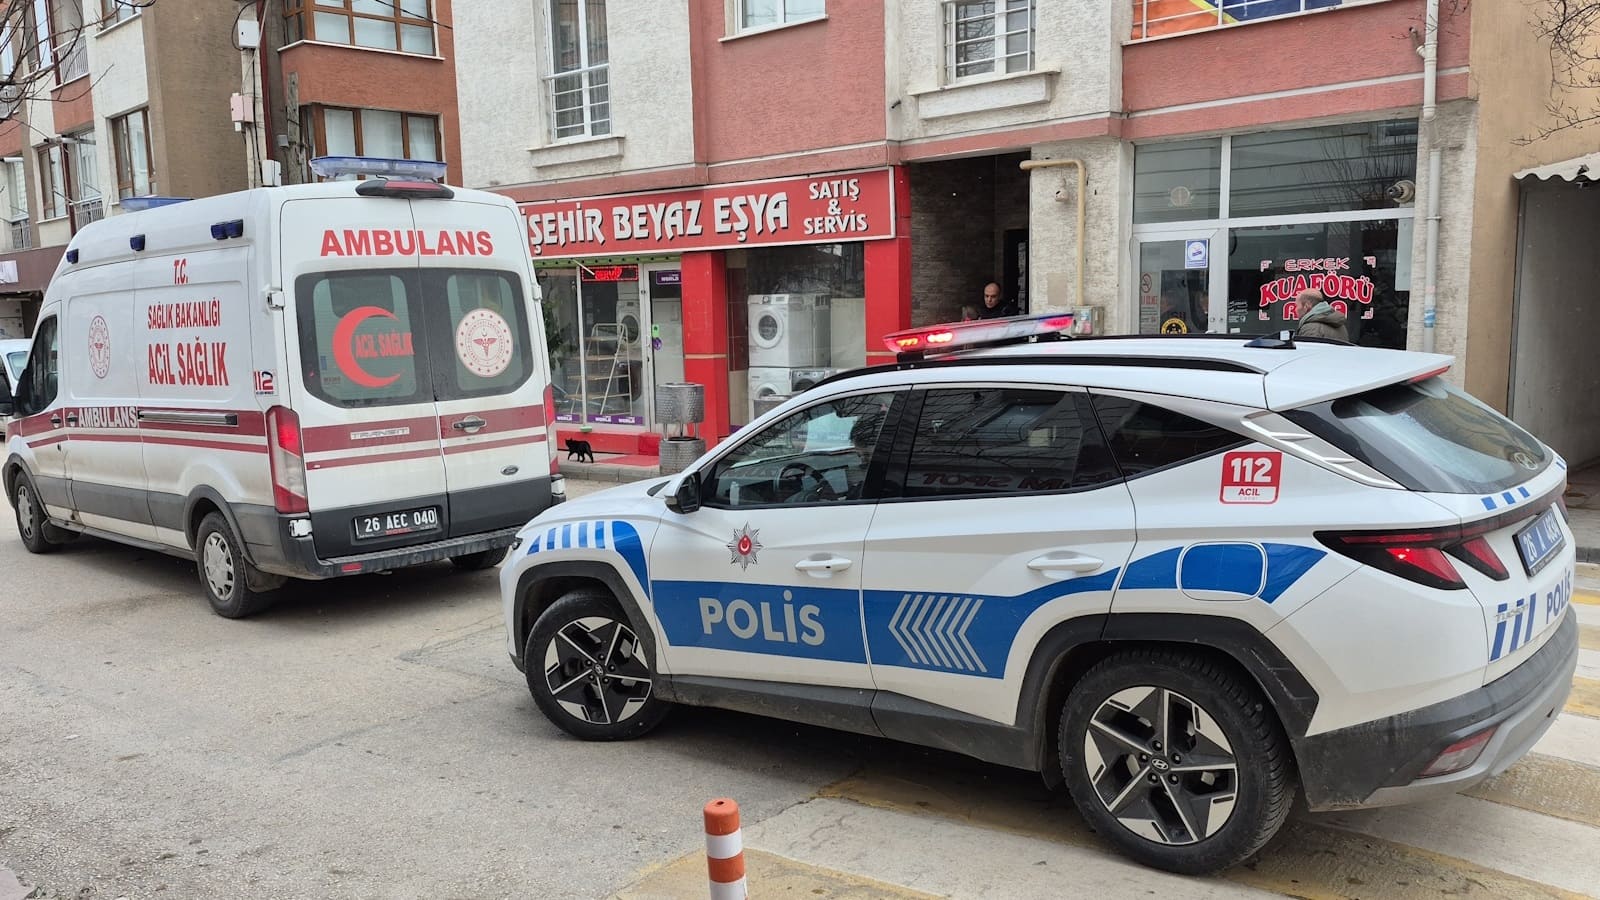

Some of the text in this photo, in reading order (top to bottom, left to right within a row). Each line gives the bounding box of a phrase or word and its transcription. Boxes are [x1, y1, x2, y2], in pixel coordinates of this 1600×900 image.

[809, 178, 860, 201] SATIŞ
[612, 199, 703, 242] BEYAZ
[714, 191, 789, 242] EŞYA
[827, 199, 842, 215] &
[803, 210, 869, 234] SERVİS
[320, 229, 493, 256] AMBULANS
[174, 258, 188, 285] T.C.
[1284, 257, 1350, 272] ERKEK
[1259, 269, 1374, 306] KUAFÖRÜ
[148, 297, 220, 330] SAĞLIK BAKANLIĞI
[177, 336, 229, 386] SAĞLIK
[254, 370, 274, 391] 112
[79, 407, 138, 428] AMBULANS
[1231, 457, 1272, 483] 112
[364, 518, 380, 533] 26
[386, 514, 408, 530] AEC
[413, 510, 435, 525] 040
[1522, 533, 1538, 562] 26
[1546, 568, 1571, 624] POLİS
[698, 589, 825, 646] POLİS
